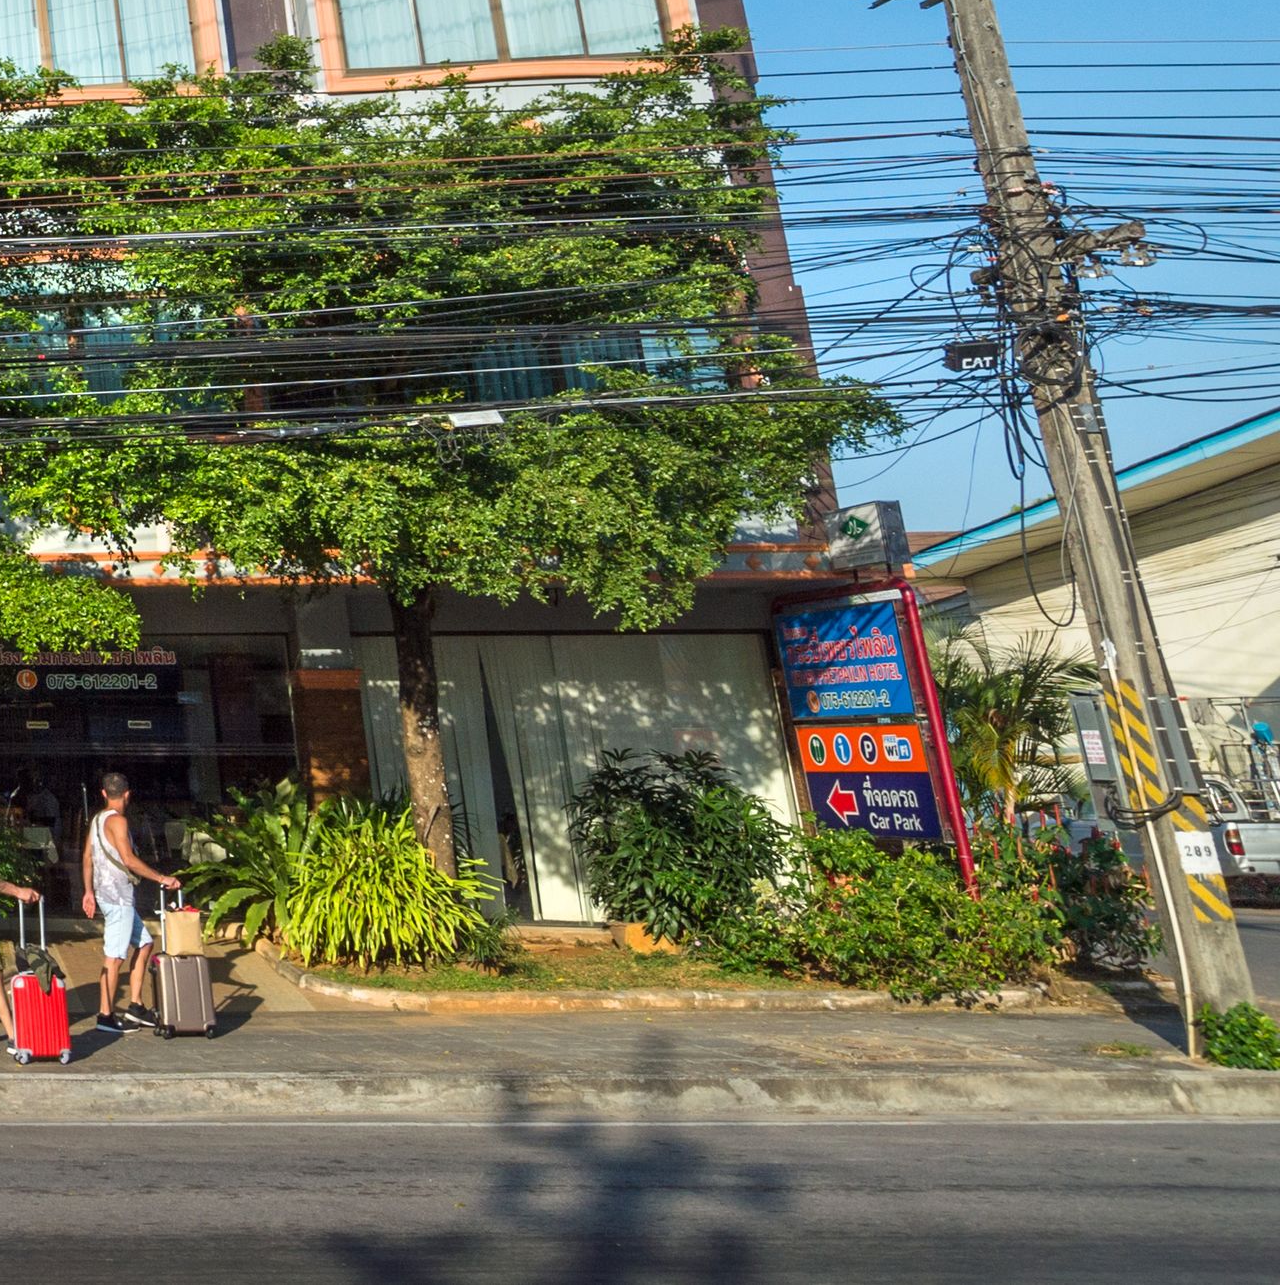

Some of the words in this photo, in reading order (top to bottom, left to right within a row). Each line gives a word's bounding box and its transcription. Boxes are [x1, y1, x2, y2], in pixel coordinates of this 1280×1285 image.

[962, 356, 993, 369] CAT
[868, 662, 902, 681] HOTEL
[46, 673, 157, 689] 075-612201-2
[820, 689, 891, 709] 075-612201-2
[863, 740, 873, 758] P
[862, 775, 919, 808] ที่จอดรถ
[869, 812, 890, 829] Car
[893, 813, 924, 831] Park
[1184, 846, 1212, 857] 289
